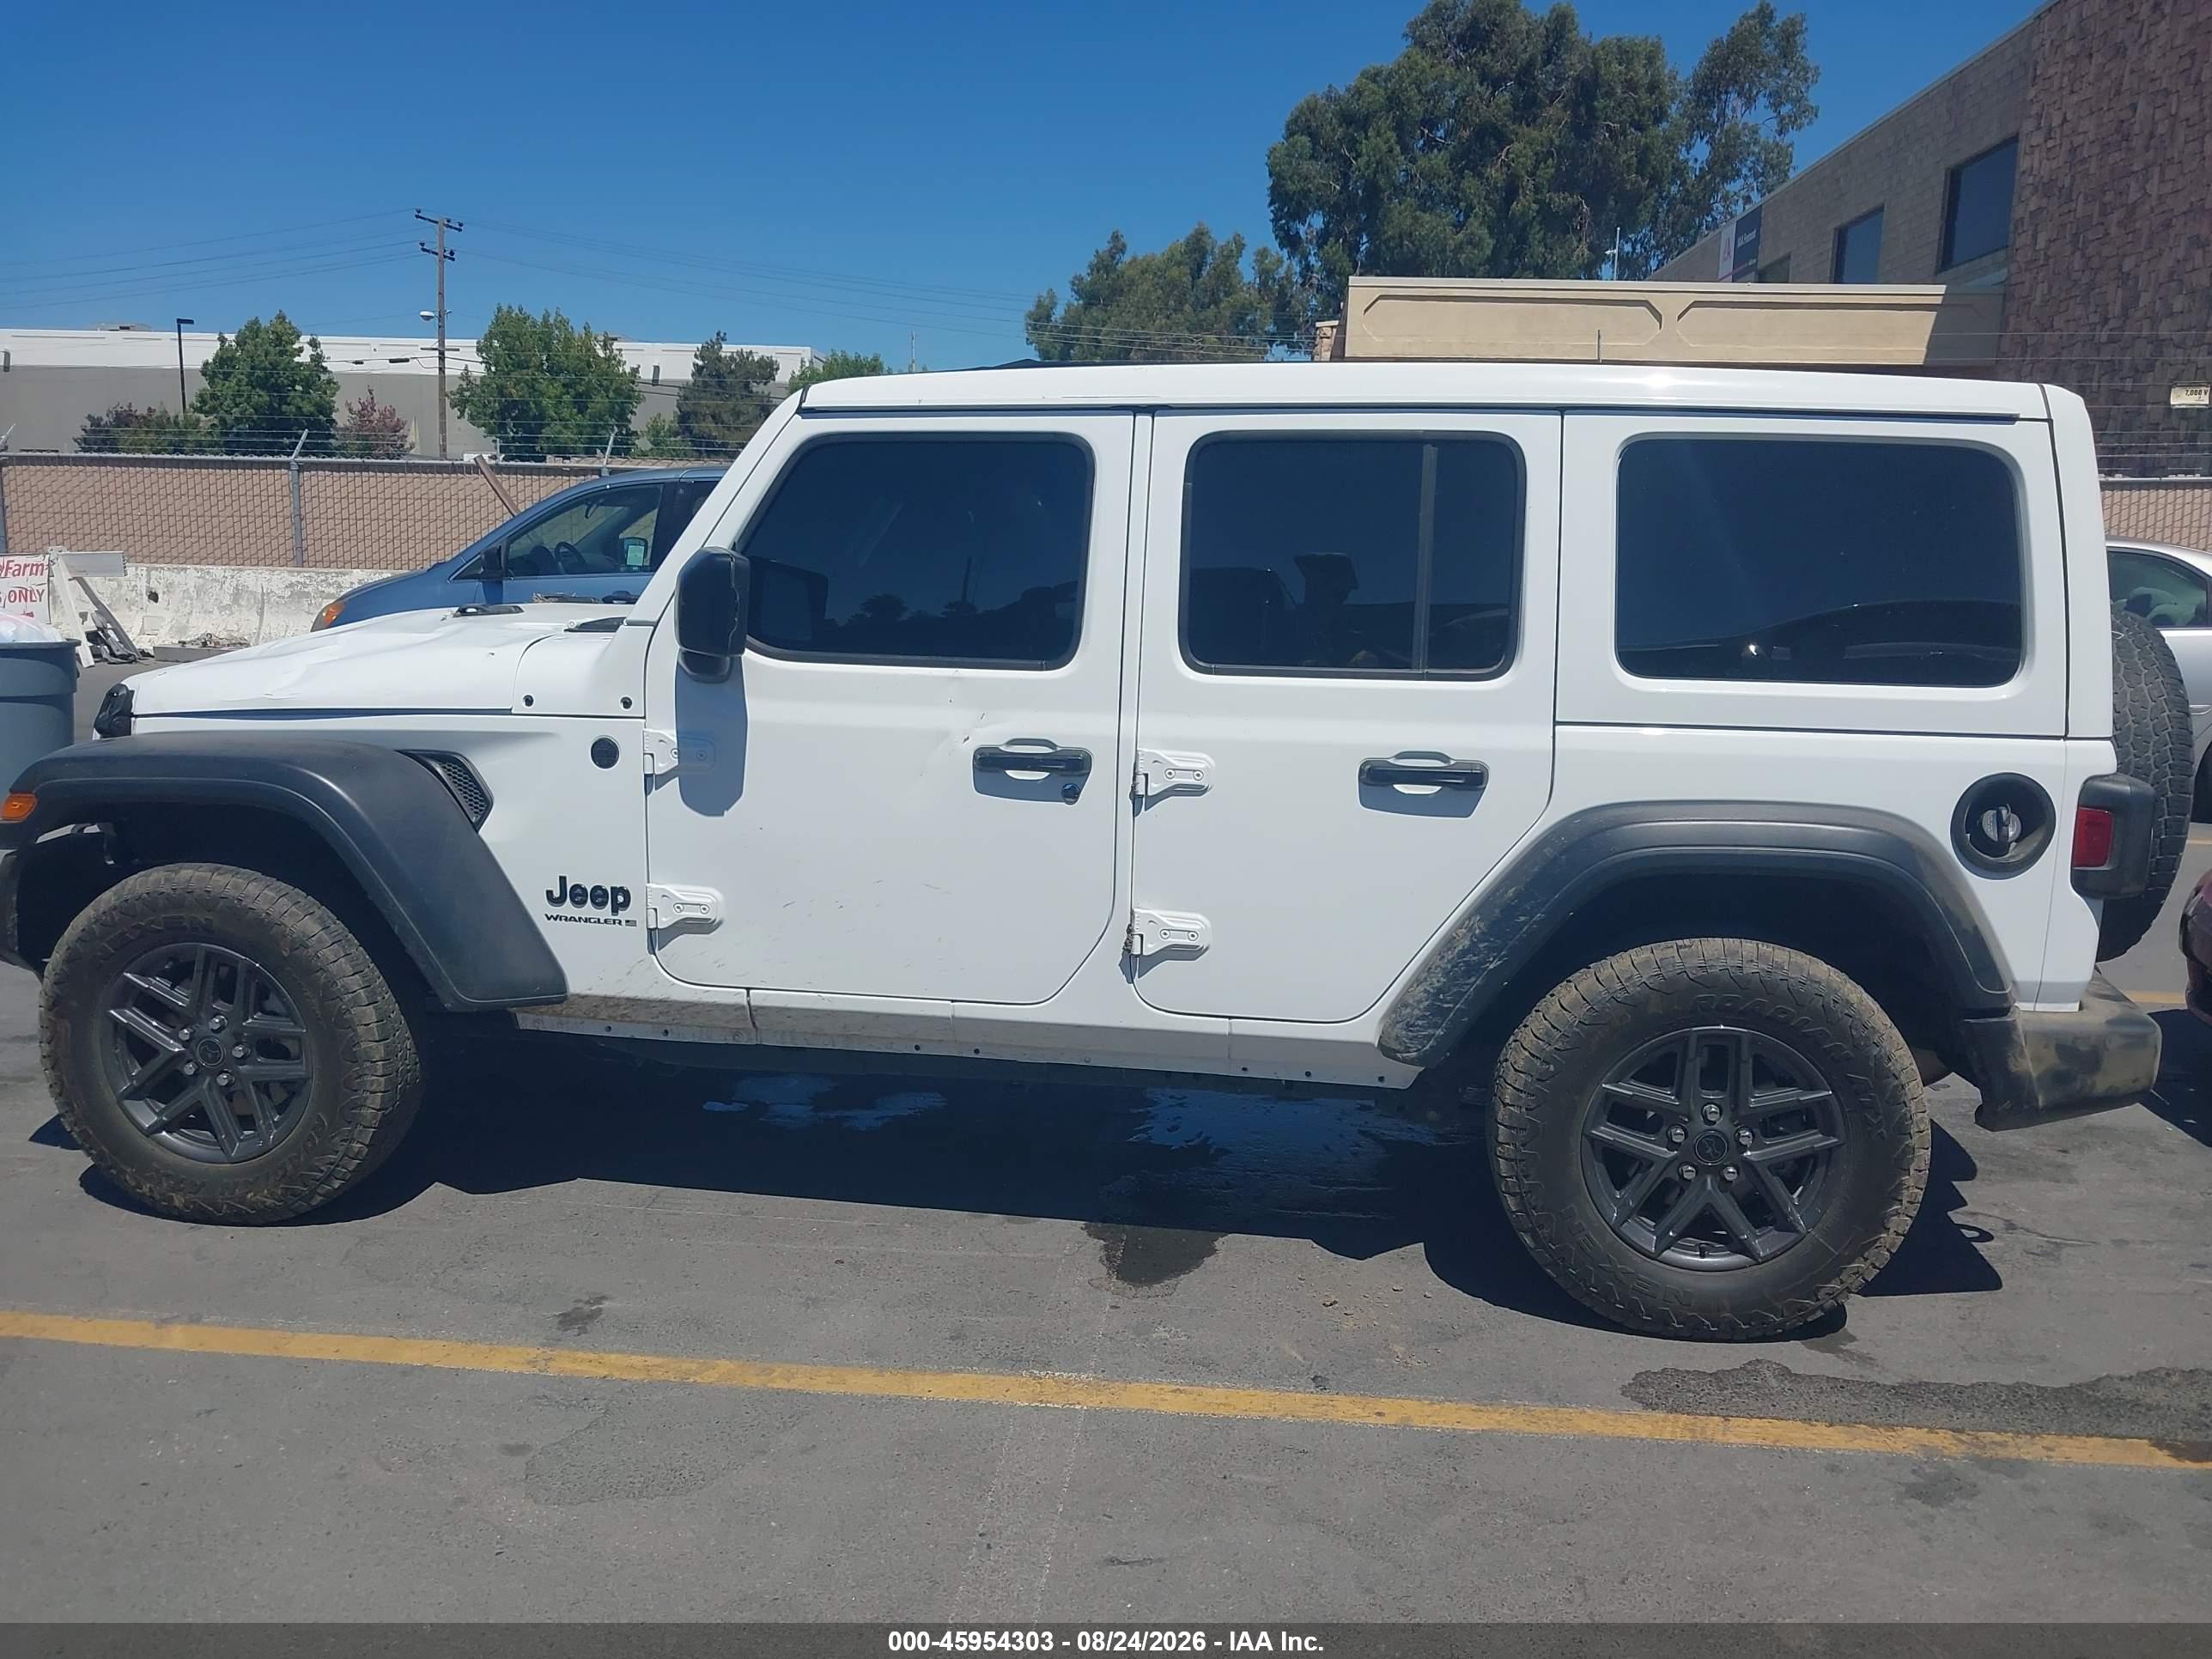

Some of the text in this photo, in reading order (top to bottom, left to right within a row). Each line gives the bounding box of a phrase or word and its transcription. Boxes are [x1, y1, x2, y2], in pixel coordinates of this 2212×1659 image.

[8, 589, 46, 603] ONLY
[545, 875, 631, 916] Jeep
[544, 913, 623, 927] WRANGLER
[1559, 1205, 1694, 1307] NEXEN
